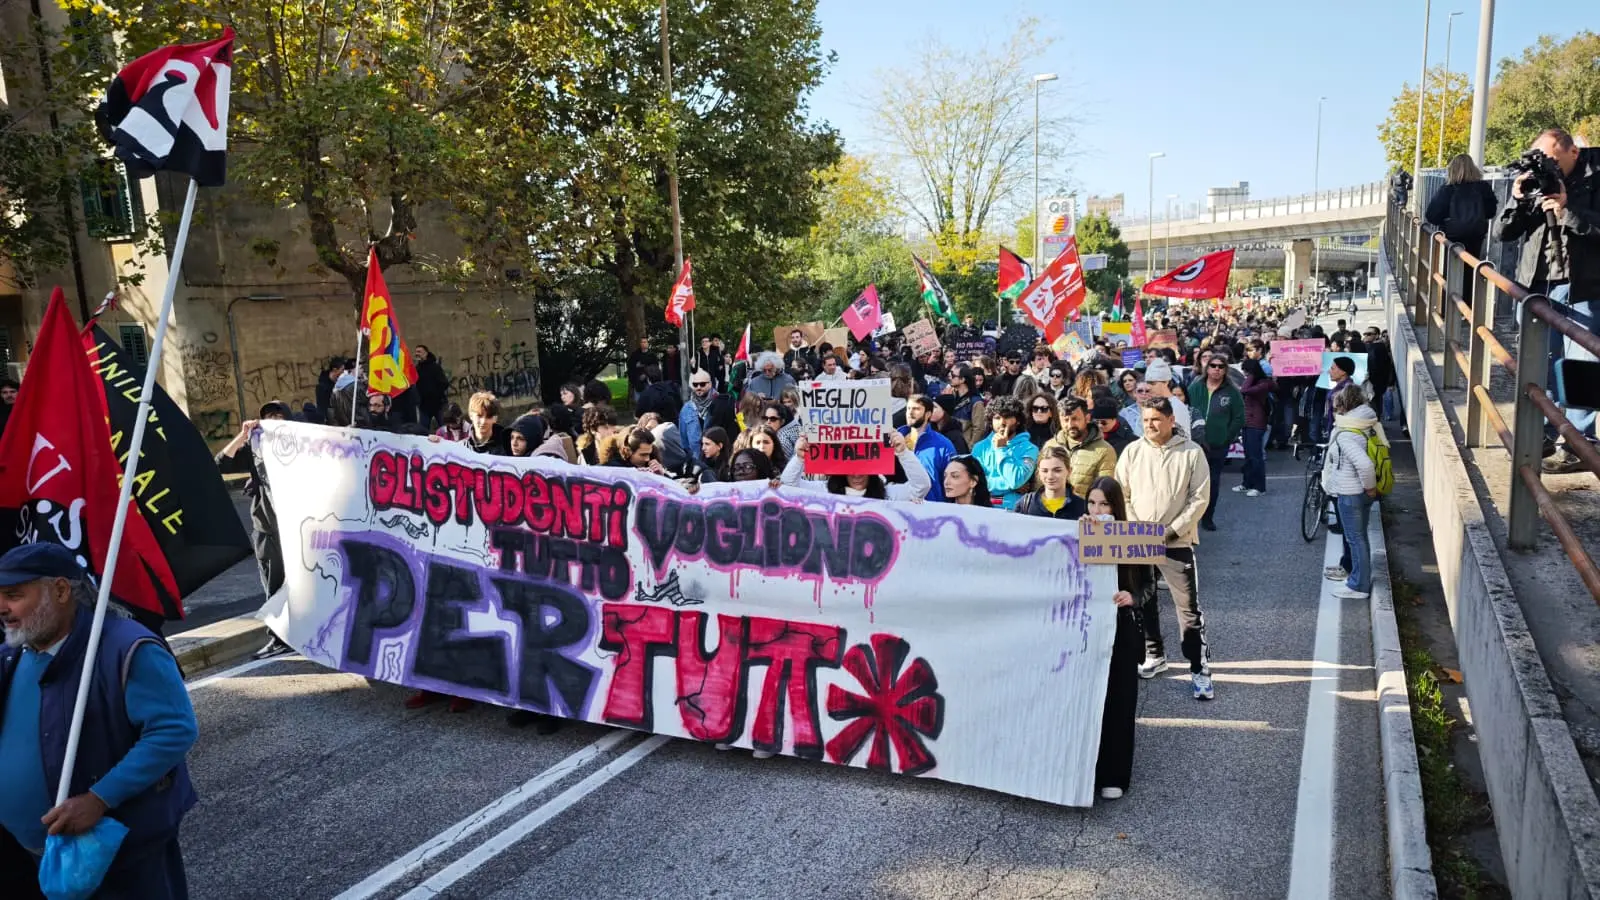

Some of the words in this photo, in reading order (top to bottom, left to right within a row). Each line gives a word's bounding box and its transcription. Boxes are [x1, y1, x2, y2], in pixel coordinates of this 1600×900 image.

[1049, 201, 1070, 213] Q8
[461, 350, 535, 374] TRIESTE
[802, 388, 867, 408] MEGLIO
[809, 408, 840, 425] FIGLI
[844, 407, 886, 425] UNICI
[1083, 521, 1095, 536] IL
[1103, 522, 1165, 537] SILENZIO
[1083, 545, 1103, 558] NON
[1109, 545, 1122, 559] TI
[491, 529, 632, 601] TUTTO
[338, 539, 602, 718] PER
